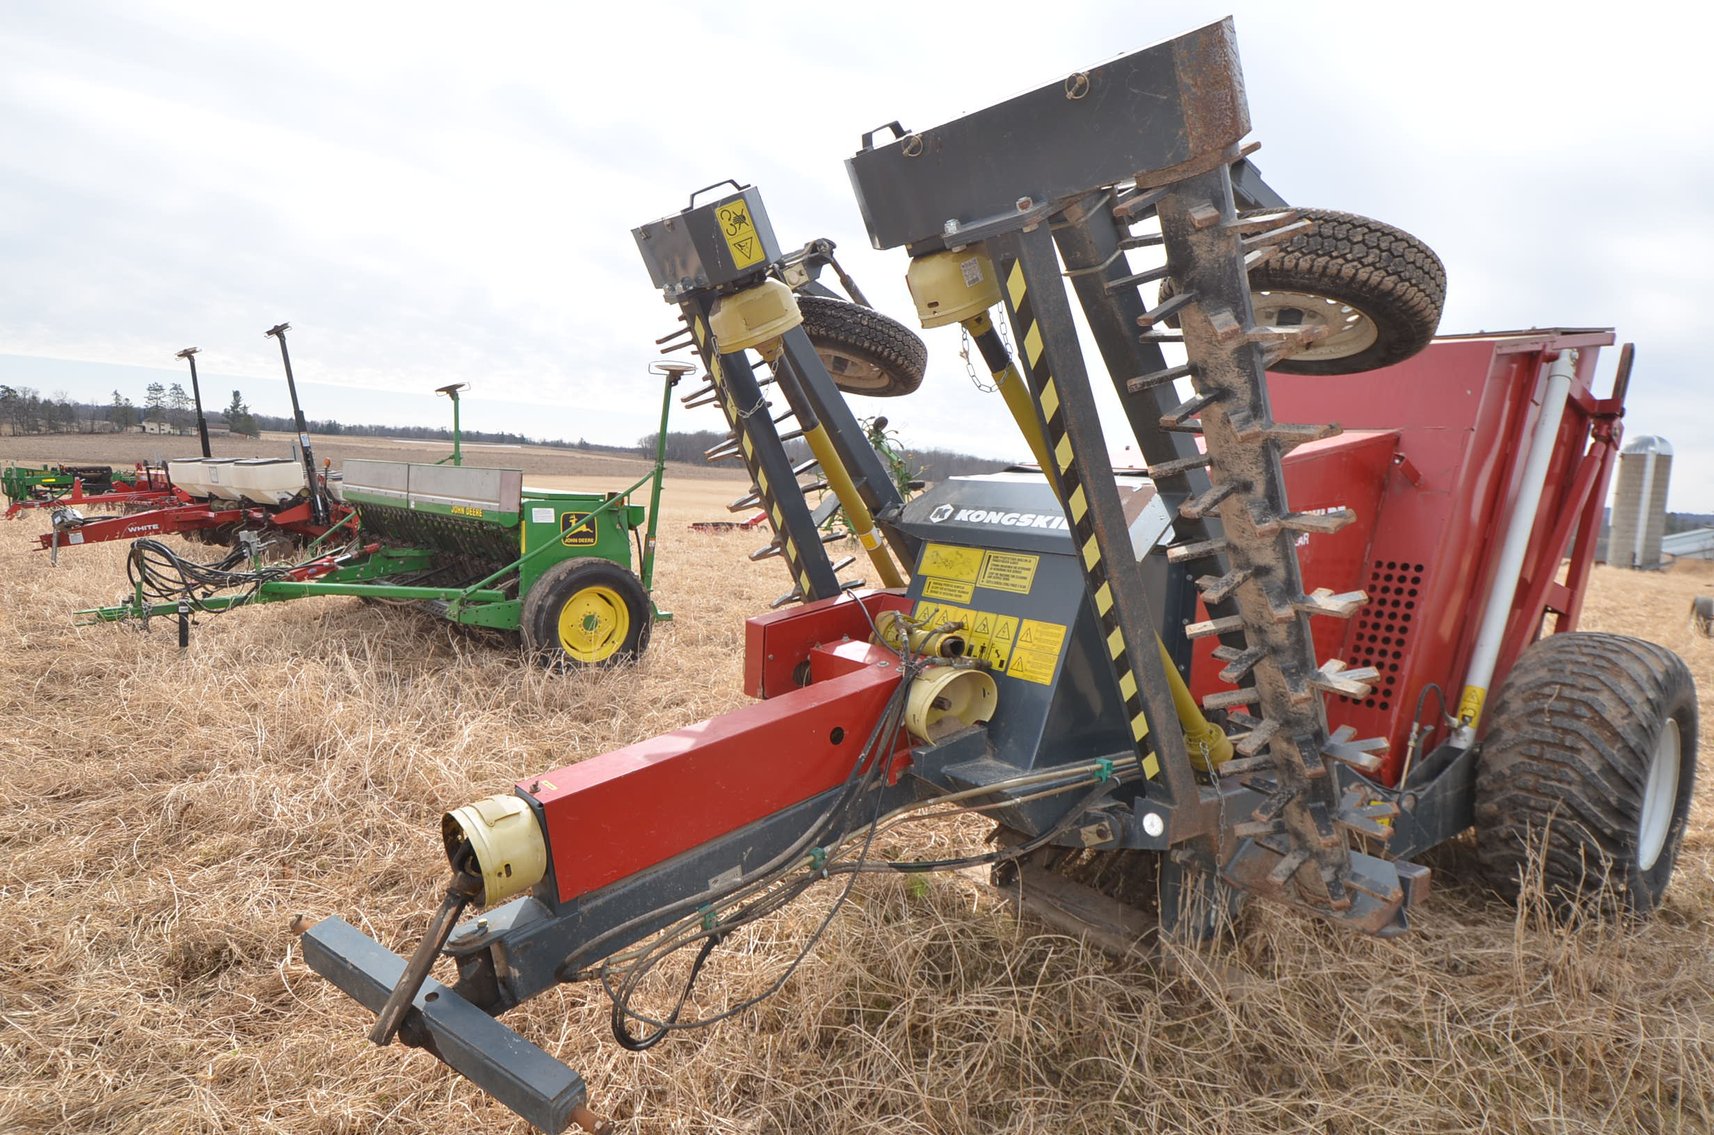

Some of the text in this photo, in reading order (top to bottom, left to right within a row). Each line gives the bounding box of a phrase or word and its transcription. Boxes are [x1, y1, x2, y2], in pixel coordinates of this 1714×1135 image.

[451, 505, 482, 517] JOHN DEERE
[127, 523, 160, 533] WHITE
